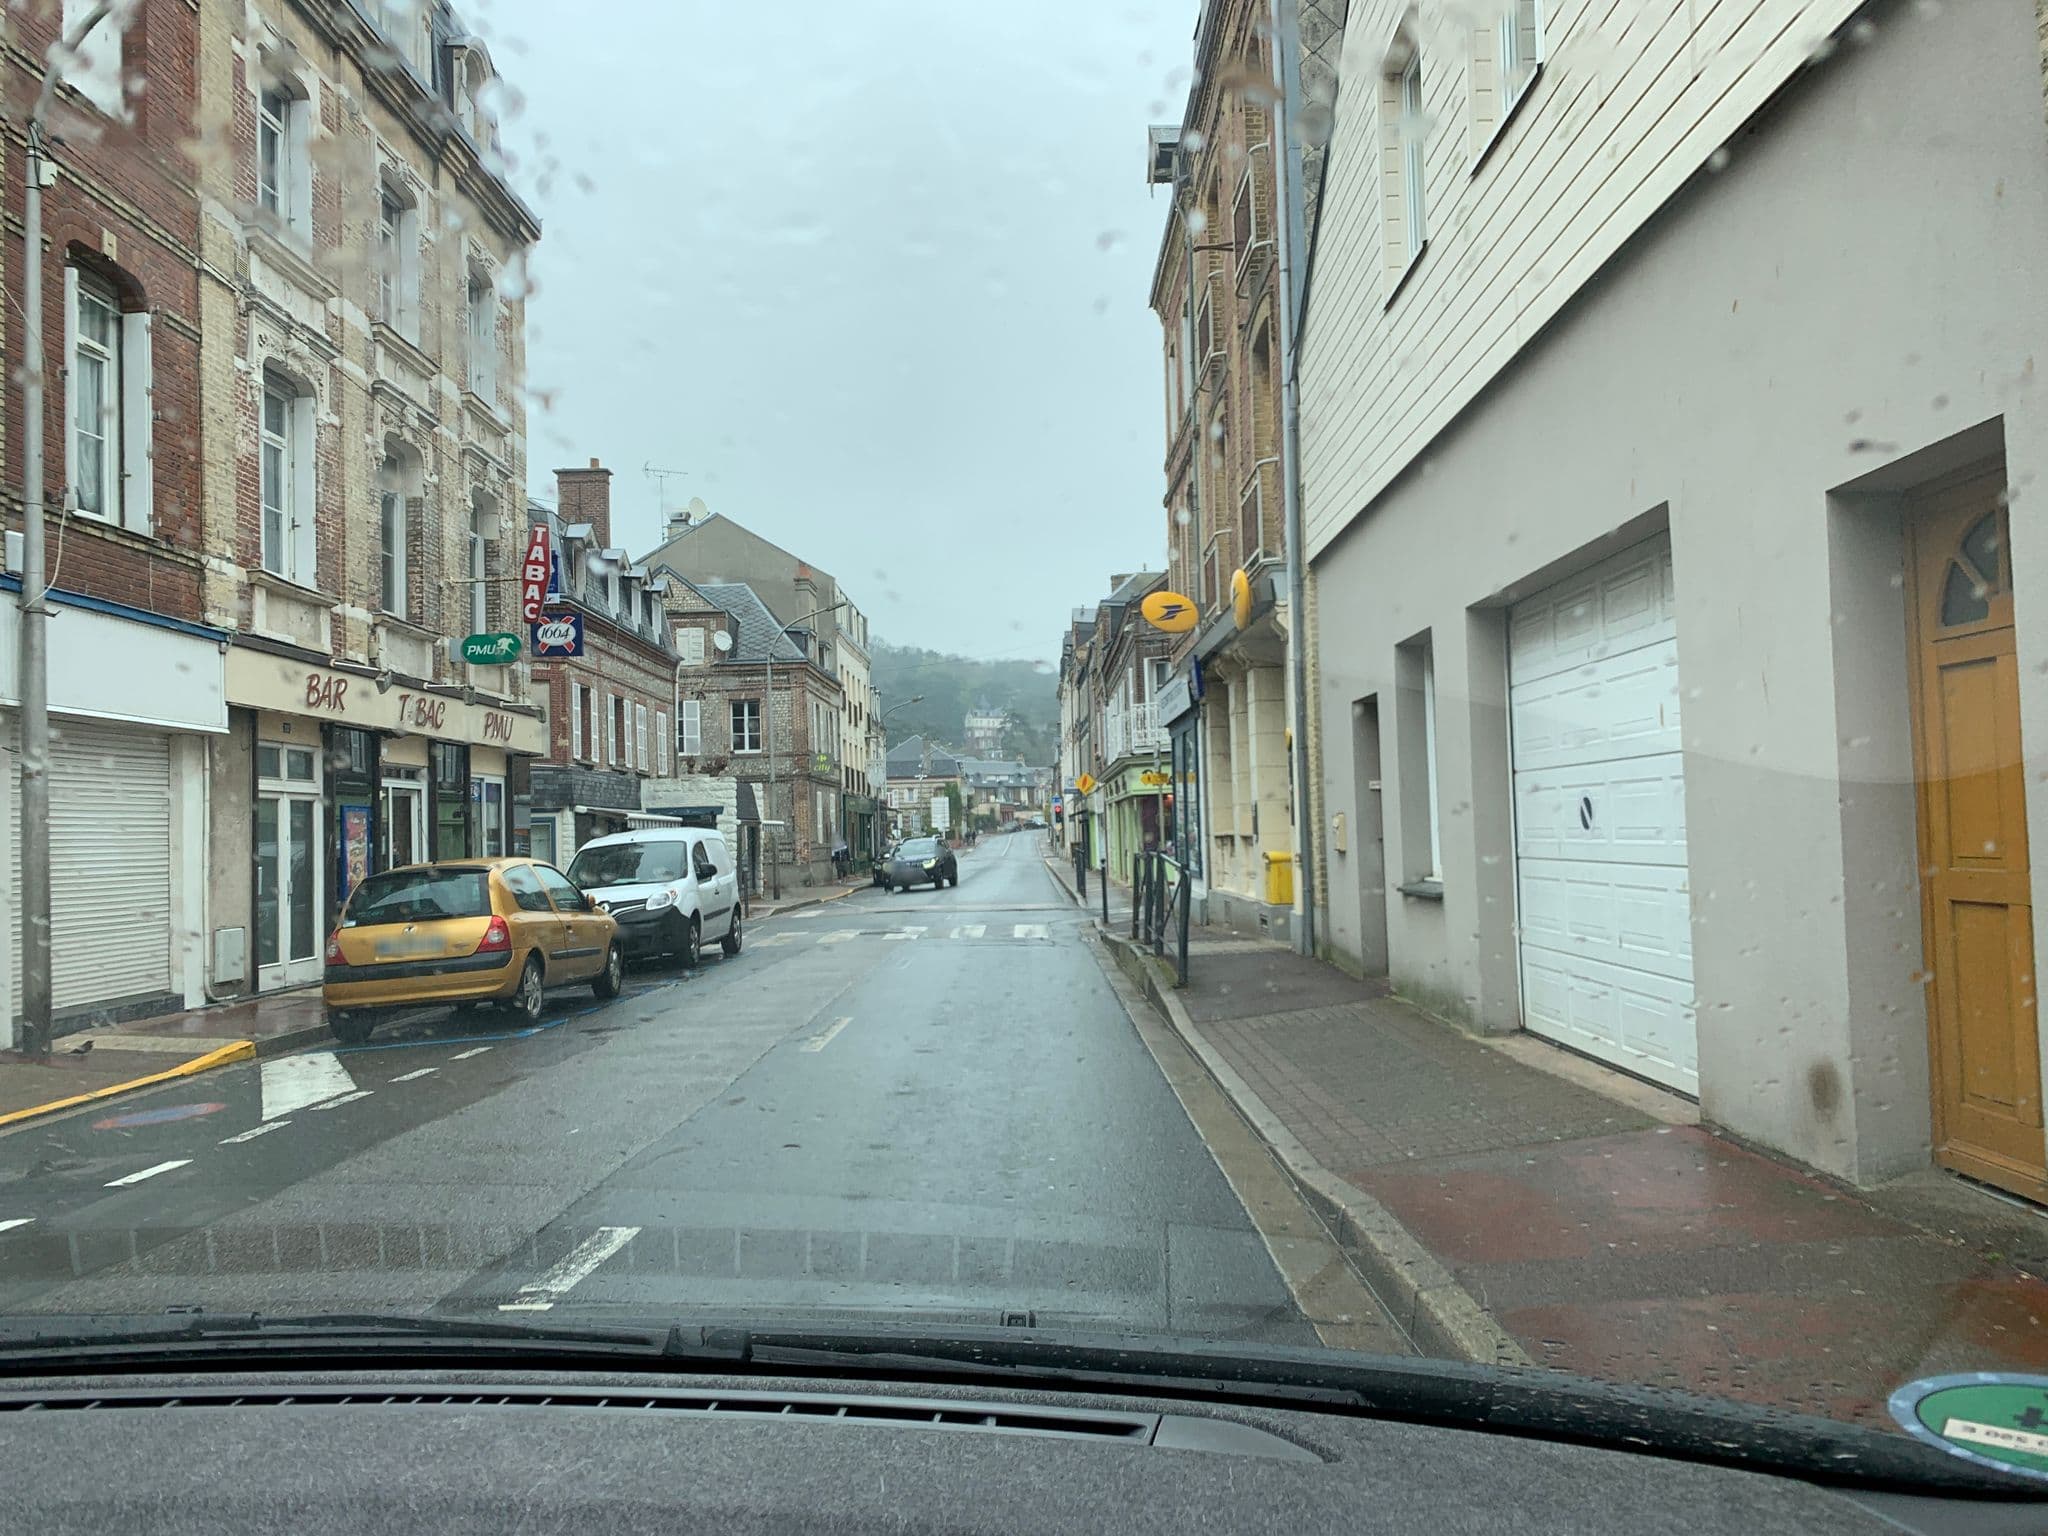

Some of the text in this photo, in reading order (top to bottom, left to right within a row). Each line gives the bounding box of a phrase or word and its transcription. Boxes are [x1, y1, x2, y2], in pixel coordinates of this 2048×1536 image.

[524, 526, 547, 619] TABAC
[466, 644, 496, 656] PMU
[541, 625, 570, 639] 1664
[306, 673, 514, 742] BAR TBAC PMU
